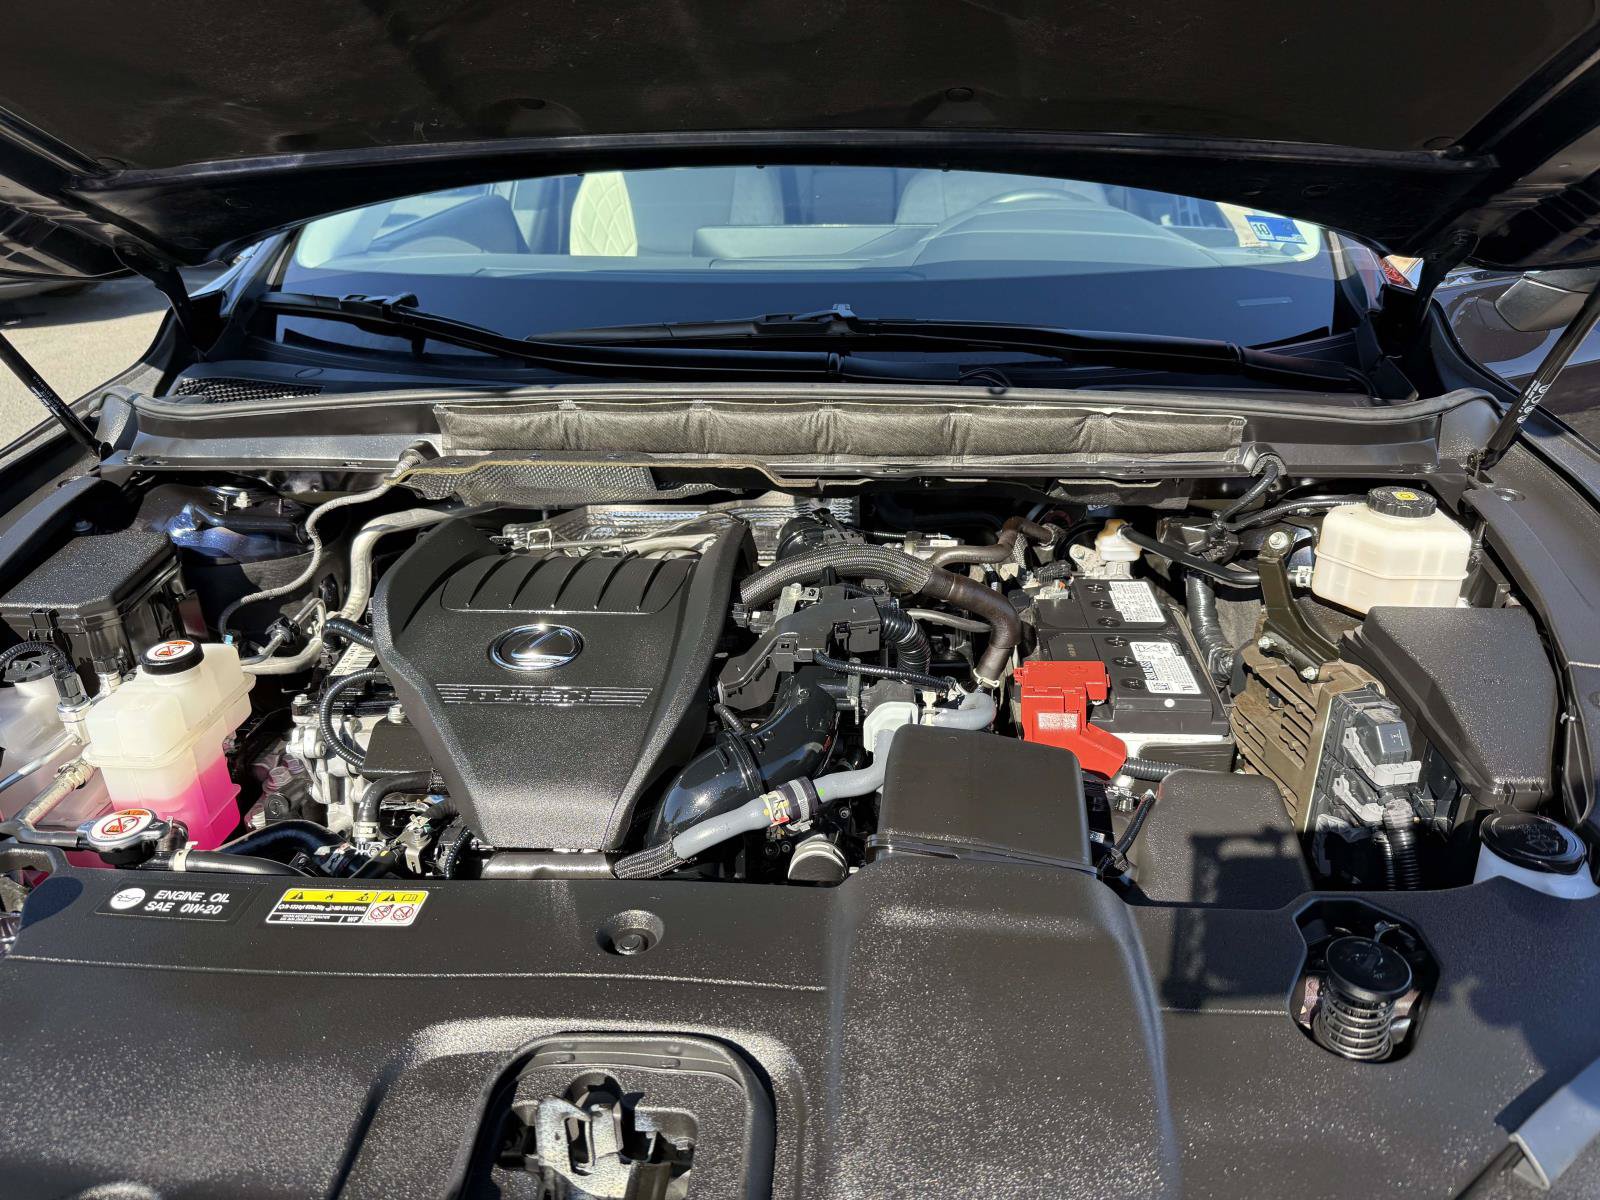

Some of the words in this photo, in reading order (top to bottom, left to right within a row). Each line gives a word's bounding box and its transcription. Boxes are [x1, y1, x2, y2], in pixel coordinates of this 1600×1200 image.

[1252, 223, 1271, 235] 10
[210, 893, 230, 903] OIL
[144, 901, 175, 912] SAE
[180, 904, 223, 915] 0W-20
